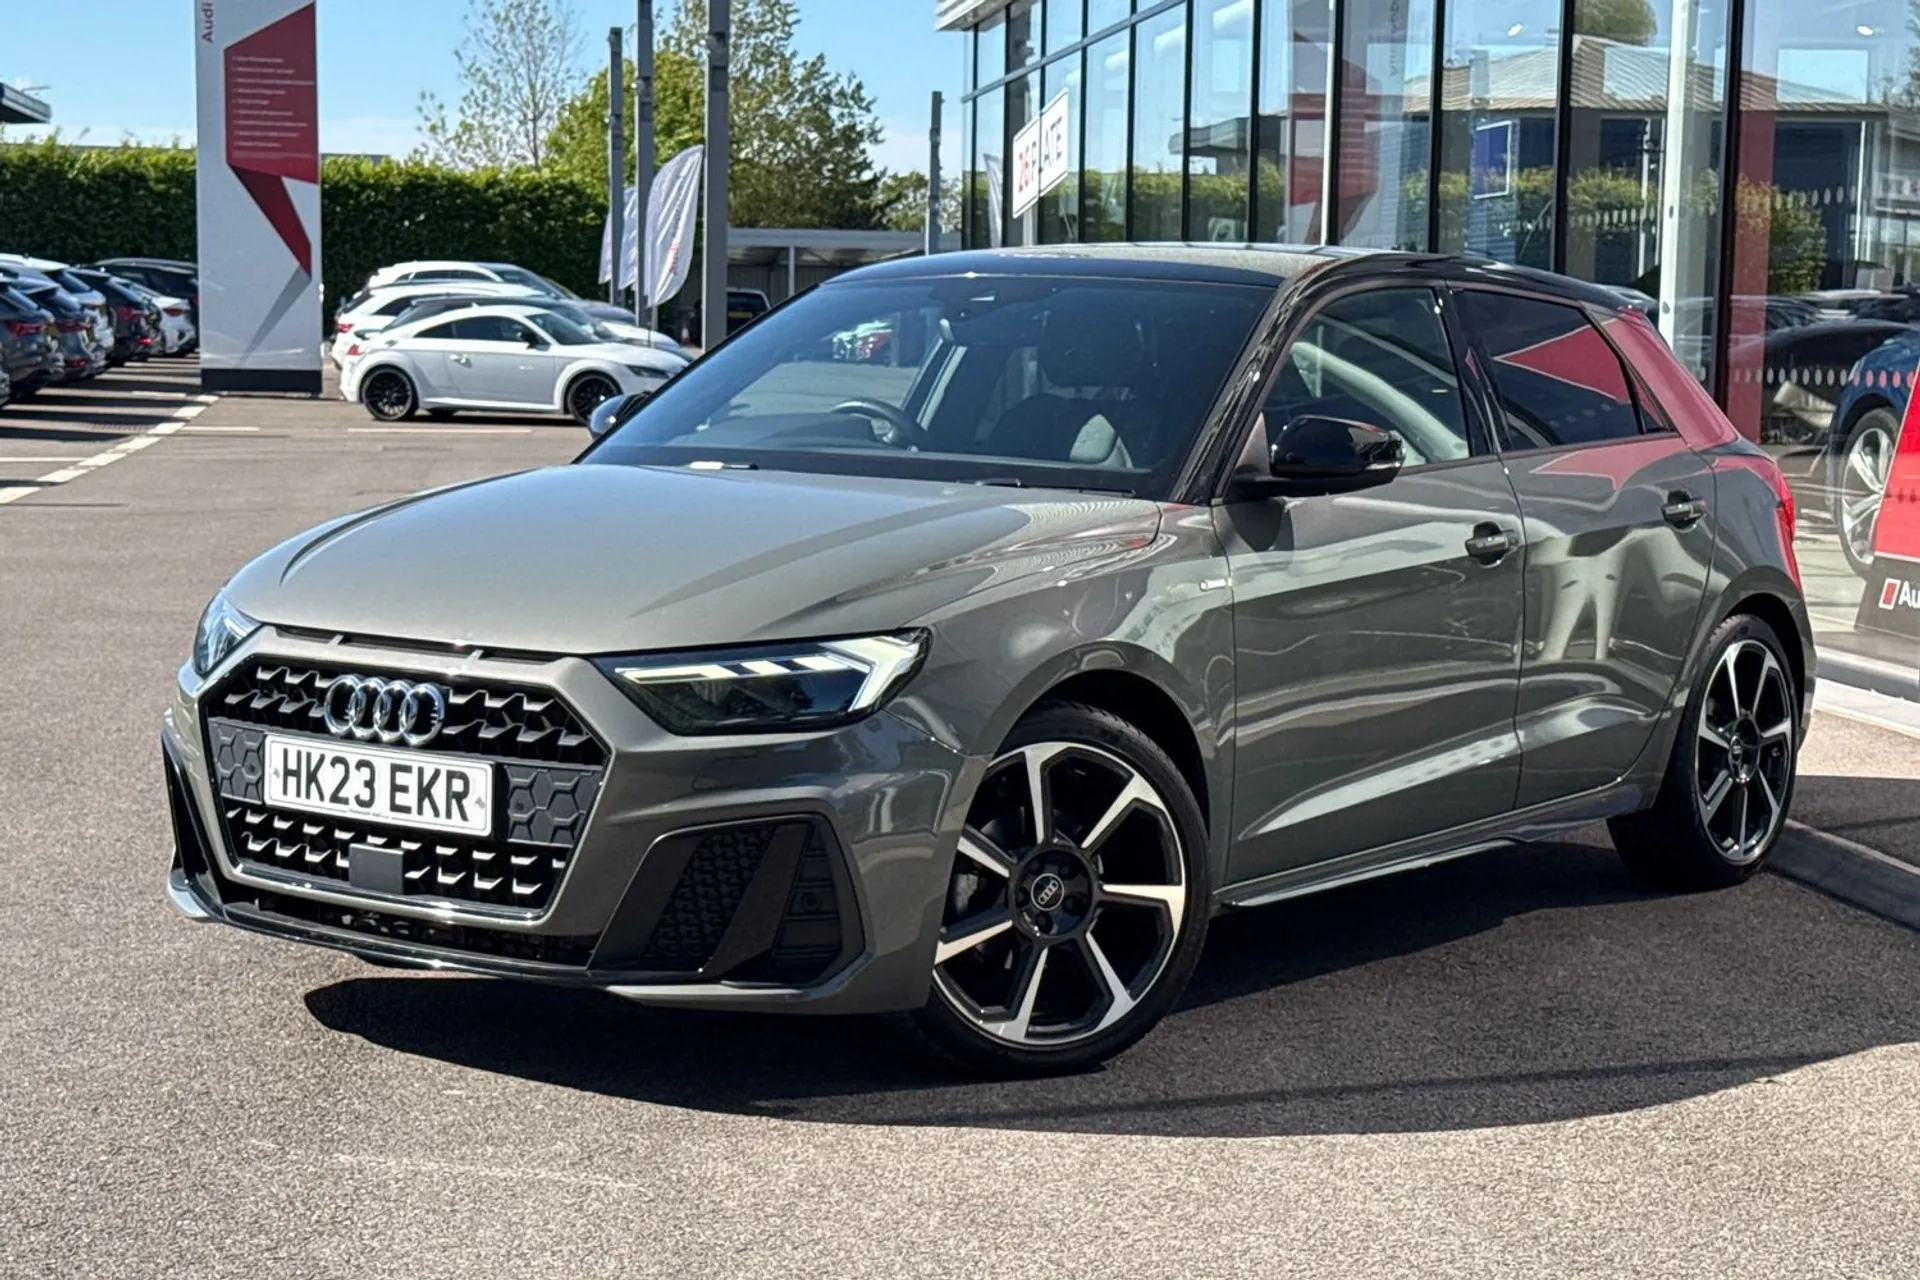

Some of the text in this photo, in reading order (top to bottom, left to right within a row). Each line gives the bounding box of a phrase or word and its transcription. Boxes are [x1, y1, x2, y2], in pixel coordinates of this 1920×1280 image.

[201, 2, 214, 43] Audi
[282, 747, 471, 822] HK23 EKR
